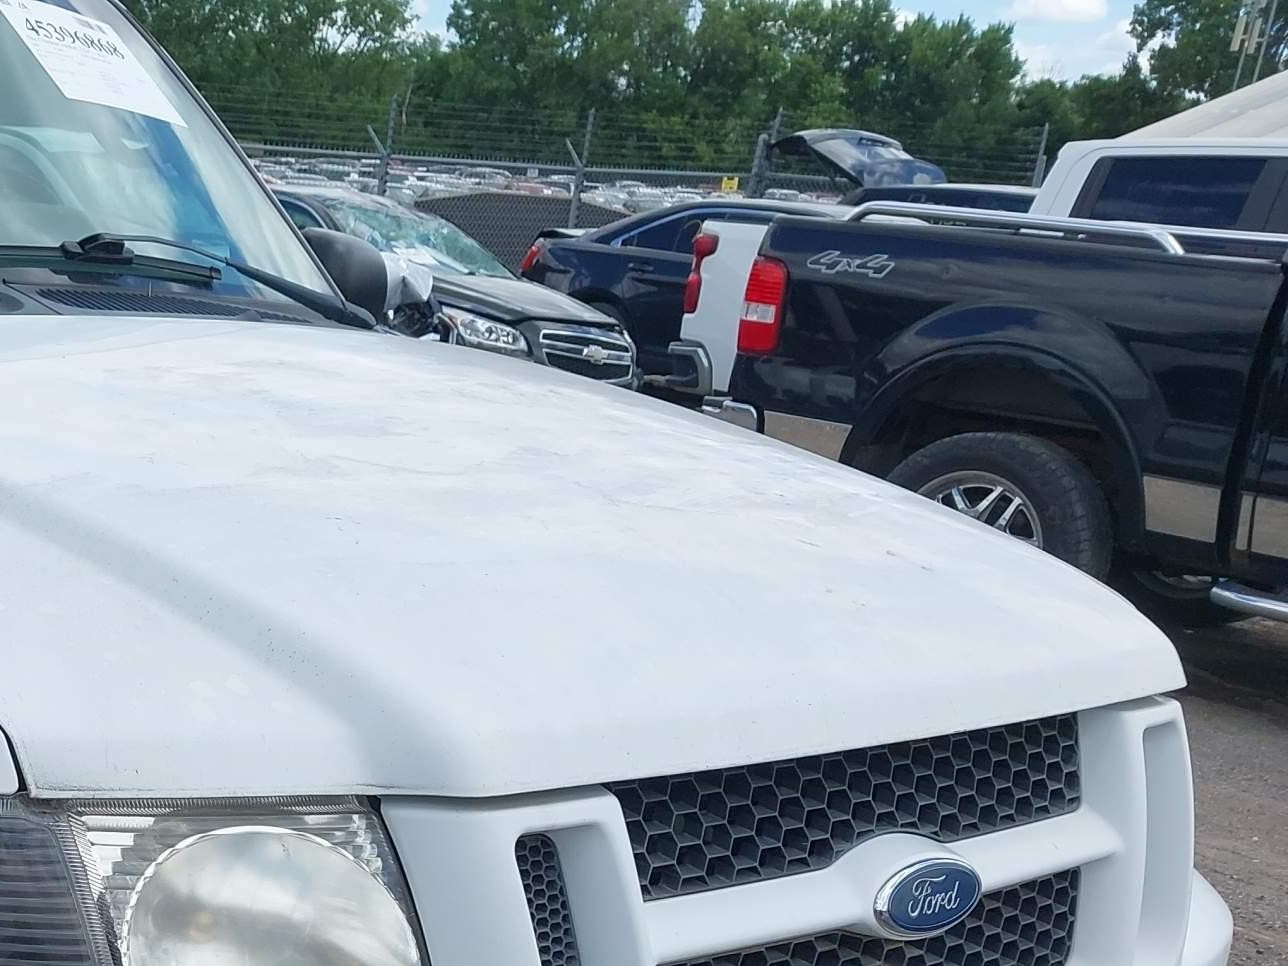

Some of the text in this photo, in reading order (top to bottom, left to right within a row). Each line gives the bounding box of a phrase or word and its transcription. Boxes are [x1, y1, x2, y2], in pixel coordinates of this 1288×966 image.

[25, 17, 125, 60] 45396868
[806, 249, 895, 279] 4x4
[908, 875, 960, 916] Ford
